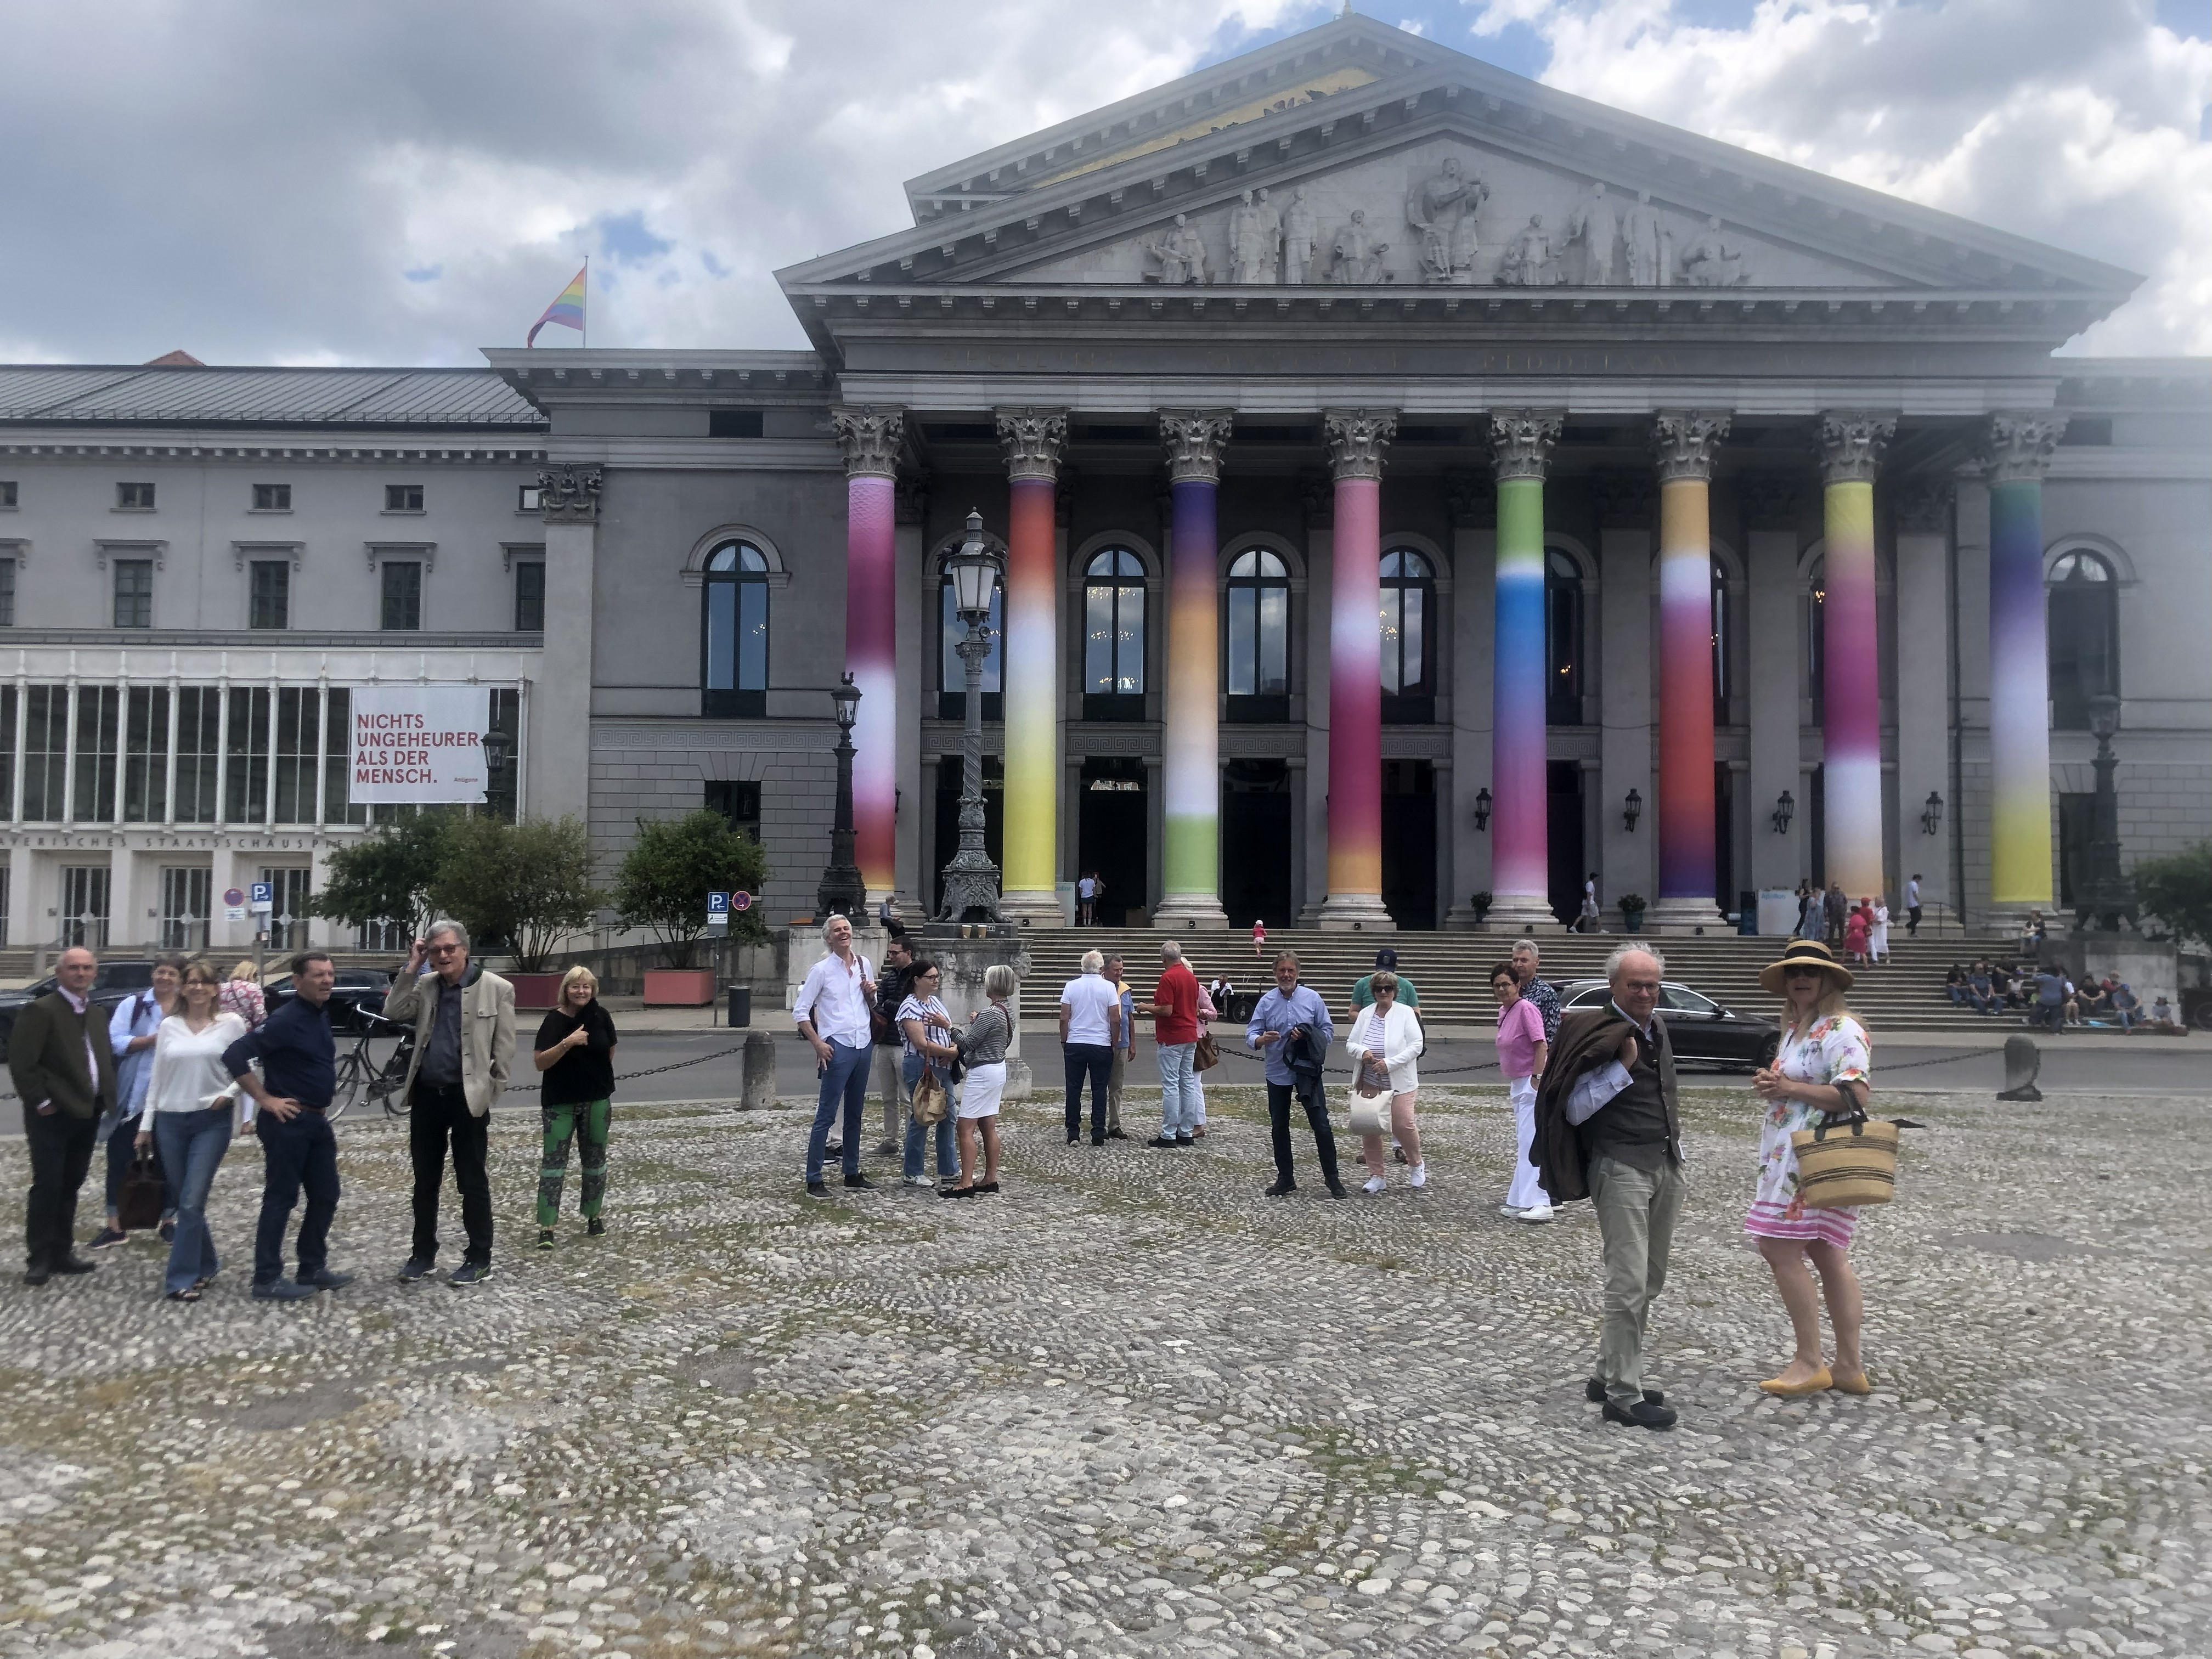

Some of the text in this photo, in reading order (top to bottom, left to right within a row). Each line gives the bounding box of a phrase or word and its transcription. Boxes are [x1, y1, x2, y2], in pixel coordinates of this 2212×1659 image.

[357, 714, 424, 729] NICHTS
[357, 732, 478, 747] UNGEHEURER
[356, 751, 428, 765] ALS DER
[357, 769, 437, 783] MENSCH.
[253, 885, 266, 900] P
[712, 895, 723, 909] P
